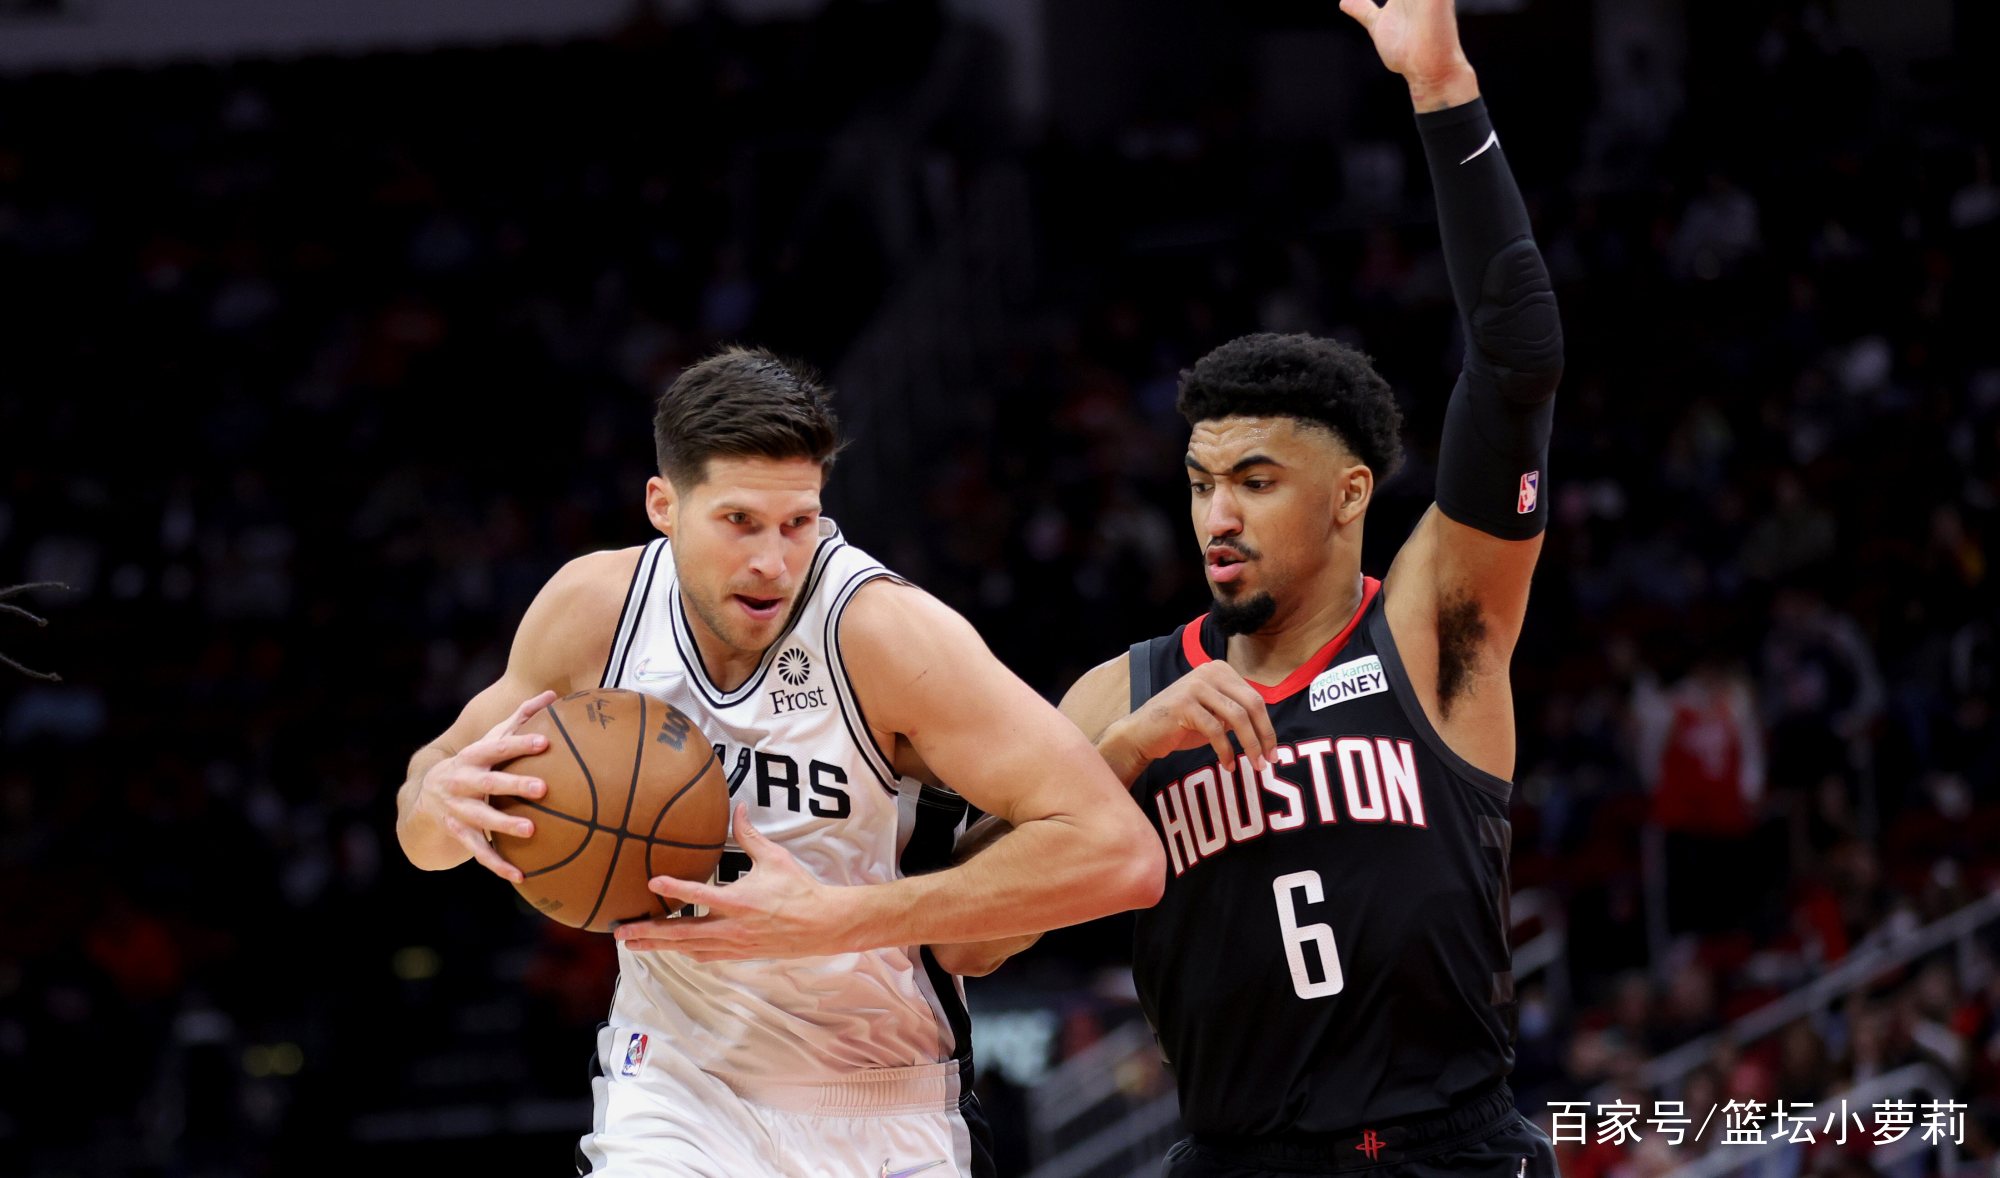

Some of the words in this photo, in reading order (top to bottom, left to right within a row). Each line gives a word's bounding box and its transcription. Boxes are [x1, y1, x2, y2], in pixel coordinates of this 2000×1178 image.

[1342, 660, 1381, 678] karma
[769, 686, 827, 714] Frost
[1312, 671, 1382, 707] MONEY
[1155, 736, 1427, 878] HOUSTON
[1272, 869, 1344, 1000] 6
